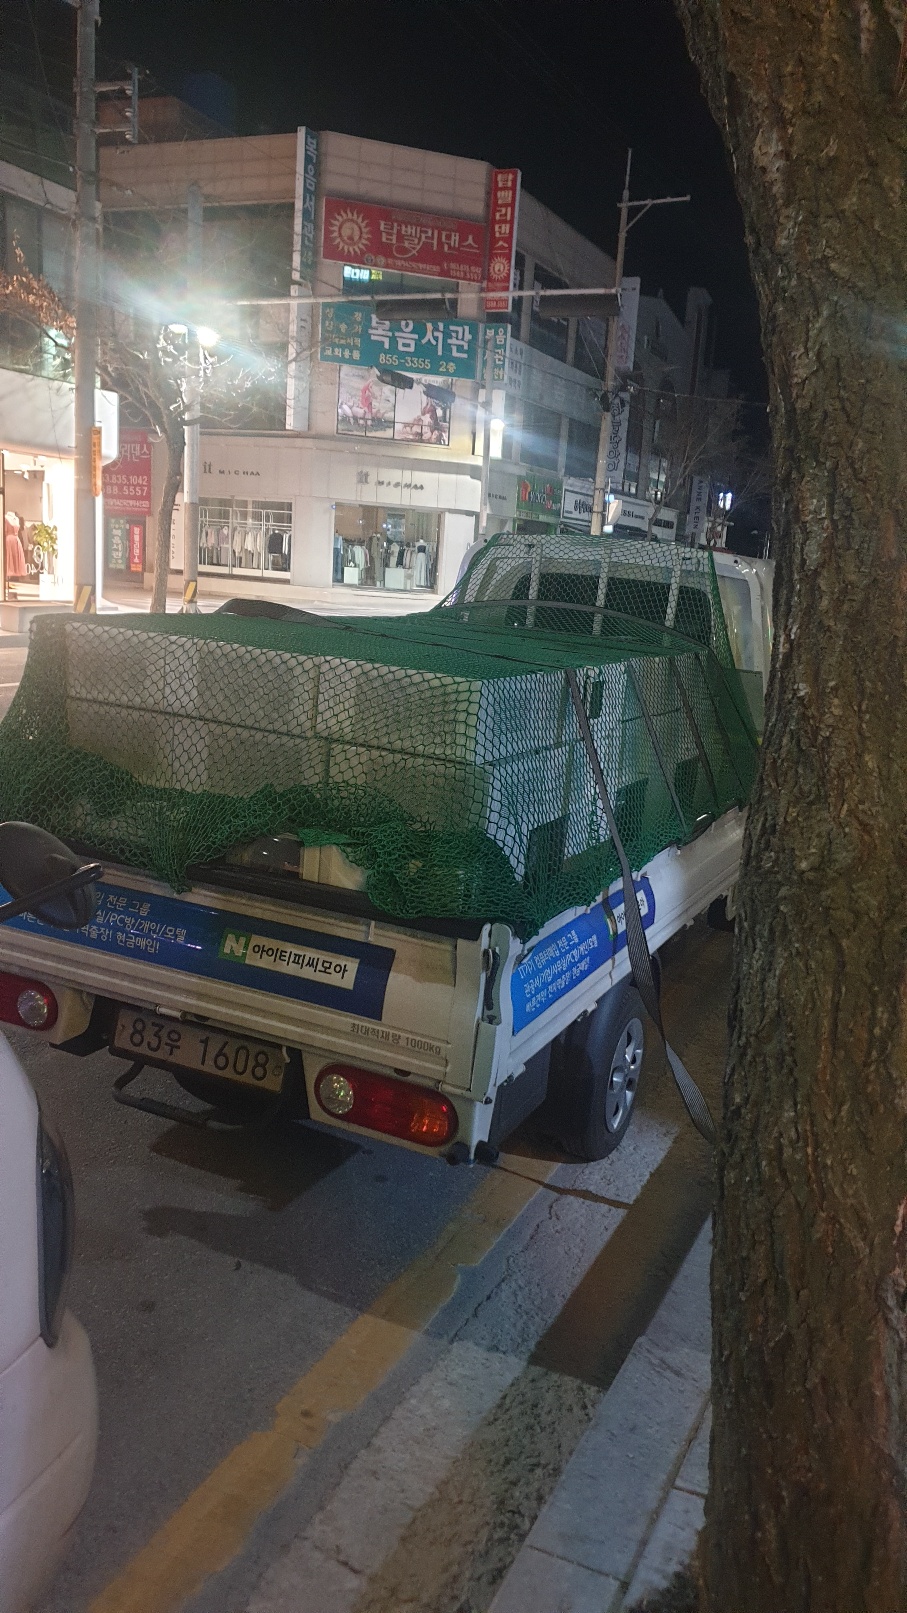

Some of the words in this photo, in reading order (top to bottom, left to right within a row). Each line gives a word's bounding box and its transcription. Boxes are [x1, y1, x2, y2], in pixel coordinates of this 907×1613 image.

[495, 171, 514, 253] 탑벨리댄스
[379, 220, 480, 253] 탑벨리댄스
[367, 313, 473, 359] 복음서관
[379, 352, 431, 370] 855-3355
[102, 473, 149, 486] 3.835.1042
[106, 893, 128, 911] 전문
[128, 902, 152, 917] 그룹
[115, 930, 161, 954] 현금매입!
[223, 933, 247, 957] N
[252, 943, 349, 981] 아이티피씨모아
[349, 1022, 402, 1046] 최대적재량
[129, 1017, 183, 1057] 83우
[199, 1035, 270, 1083] 1608
